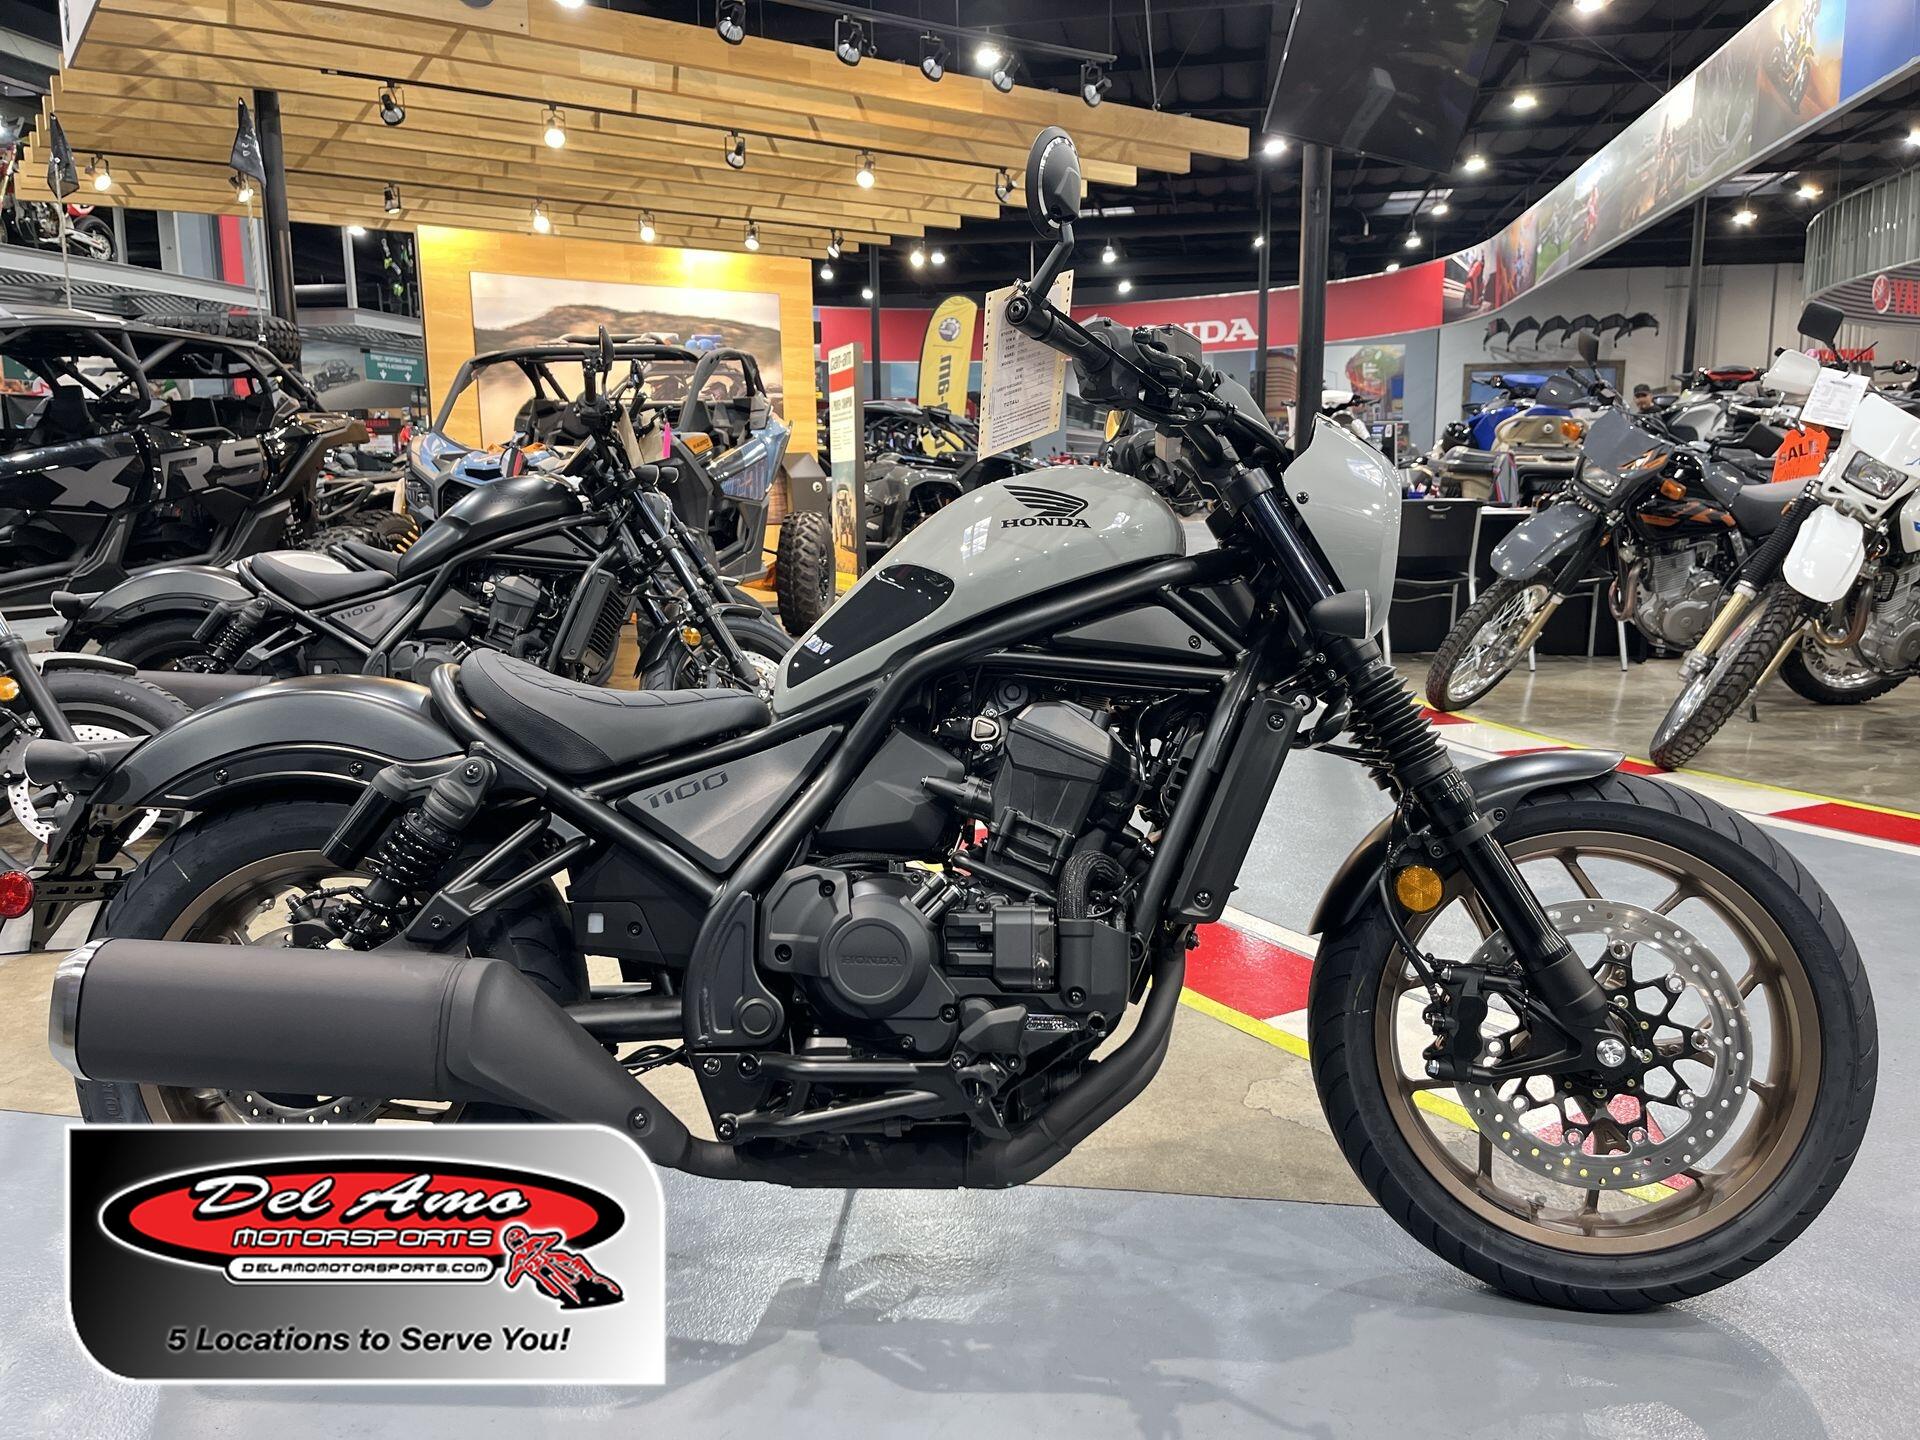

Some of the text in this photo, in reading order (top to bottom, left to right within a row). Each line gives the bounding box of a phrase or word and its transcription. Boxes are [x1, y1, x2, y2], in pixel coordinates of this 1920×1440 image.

[1892, 279, 1920, 315] YA
[1777, 440, 1820, 466] SALE
[1000, 517, 1092, 529] HONDA
[337, 604, 376, 620] 1100
[643, 769, 729, 809] 1100
[840, 954, 903, 968] HONDA
